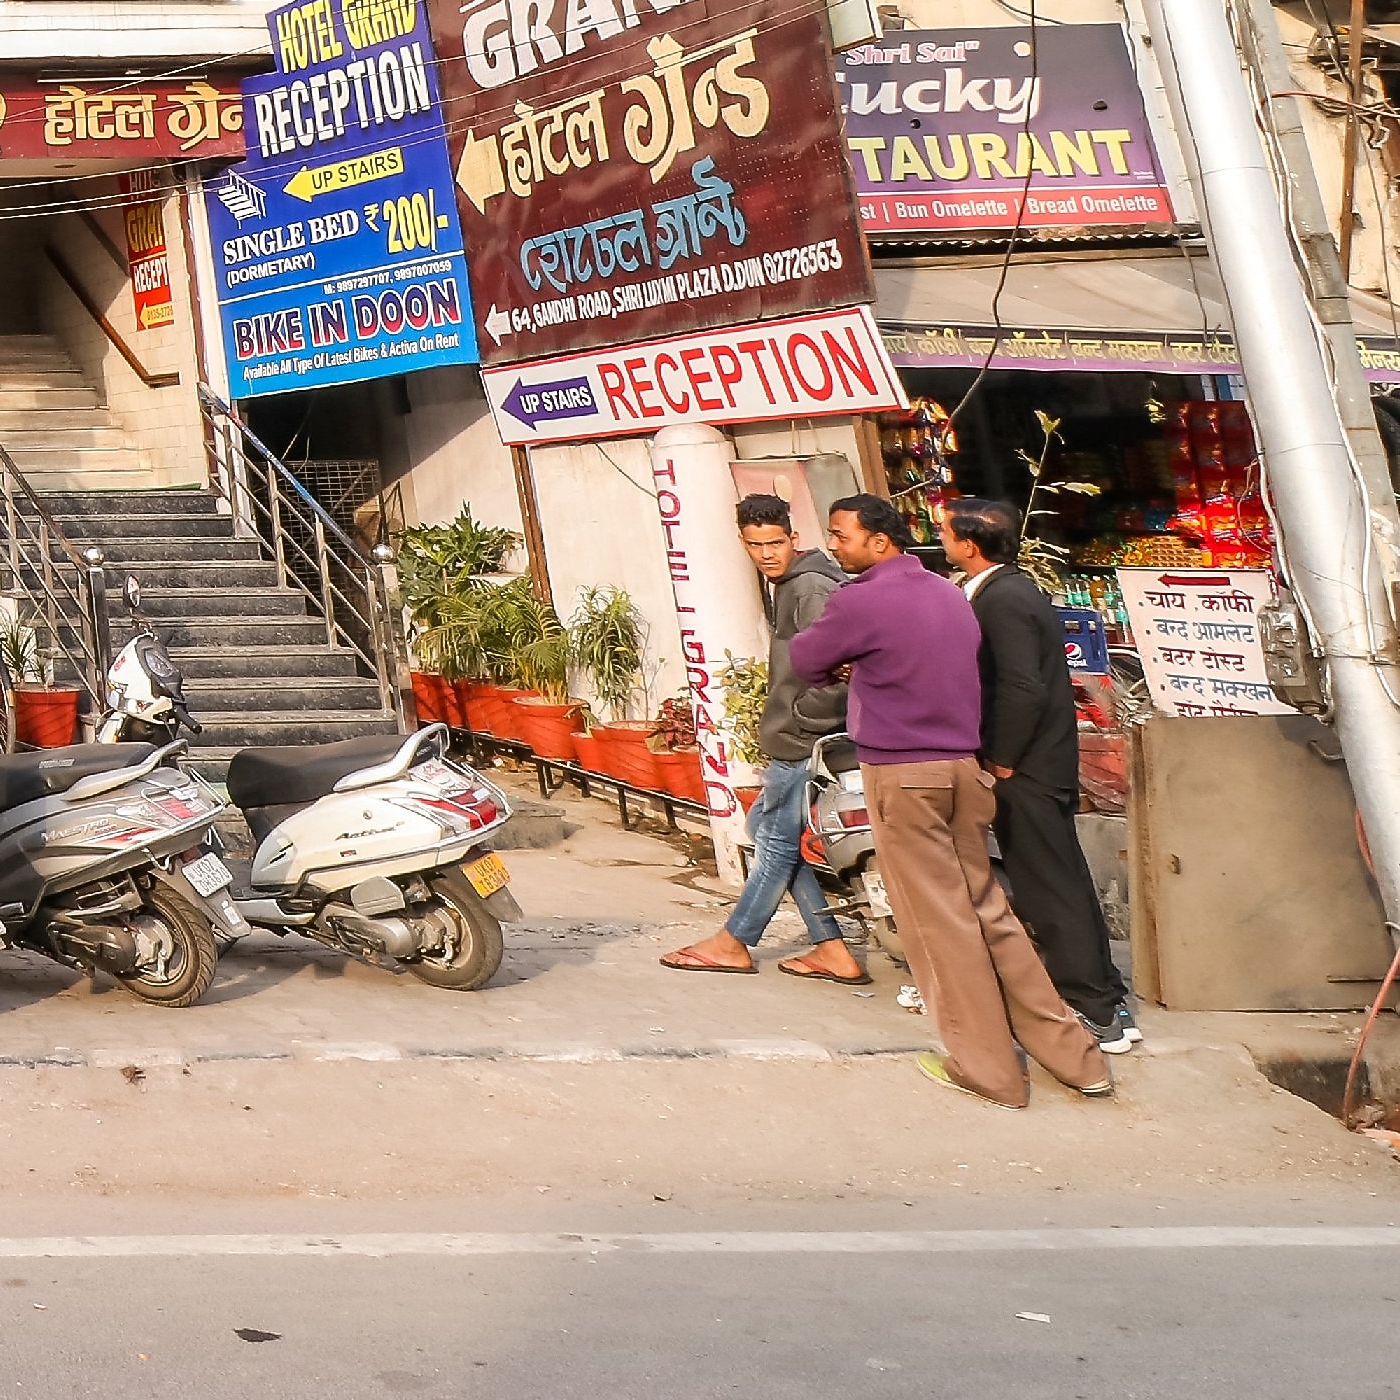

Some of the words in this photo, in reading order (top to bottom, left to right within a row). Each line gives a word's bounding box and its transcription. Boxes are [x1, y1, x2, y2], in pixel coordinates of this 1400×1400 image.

[43, 83, 157, 146] होटल
[254, 41, 433, 159] RECEPTION
[311, 166, 336, 190] UP
[338, 152, 399, 185] STAIRS
[498, 88, 609, 198] होटल
[847, 129, 1133, 183] TAURANT
[896, 201, 929, 219] Bun
[931, 199, 1008, 217] Omelette
[1027, 197, 1079, 215] Bread
[1081, 195, 1158, 214] Omelette
[222, 221, 306, 265] SINGLE
[308, 207, 359, 247] BED
[226, 252, 316, 288] (DORMETARY)
[533, 301, 576, 329] GANDHI
[678, 262, 719, 301] PLAZA
[233, 304, 306, 360] BIKE
[306, 297, 349, 348] IN
[353, 276, 463, 341] DOON
[292, 353, 313, 377] Type
[325, 350, 352, 368] Latest
[352, 346, 379, 365] Bikes
[388, 340, 418, 358] Activa
[419, 336, 434, 352] On
[434, 333, 459, 350] Rent
[519, 393, 540, 413] UP
[541, 386, 592, 412] STAIRS
[596, 326, 880, 422] RECEPTION
[1144, 590, 1186, 612] चाय
[1162, 648, 1196, 669] बटर
